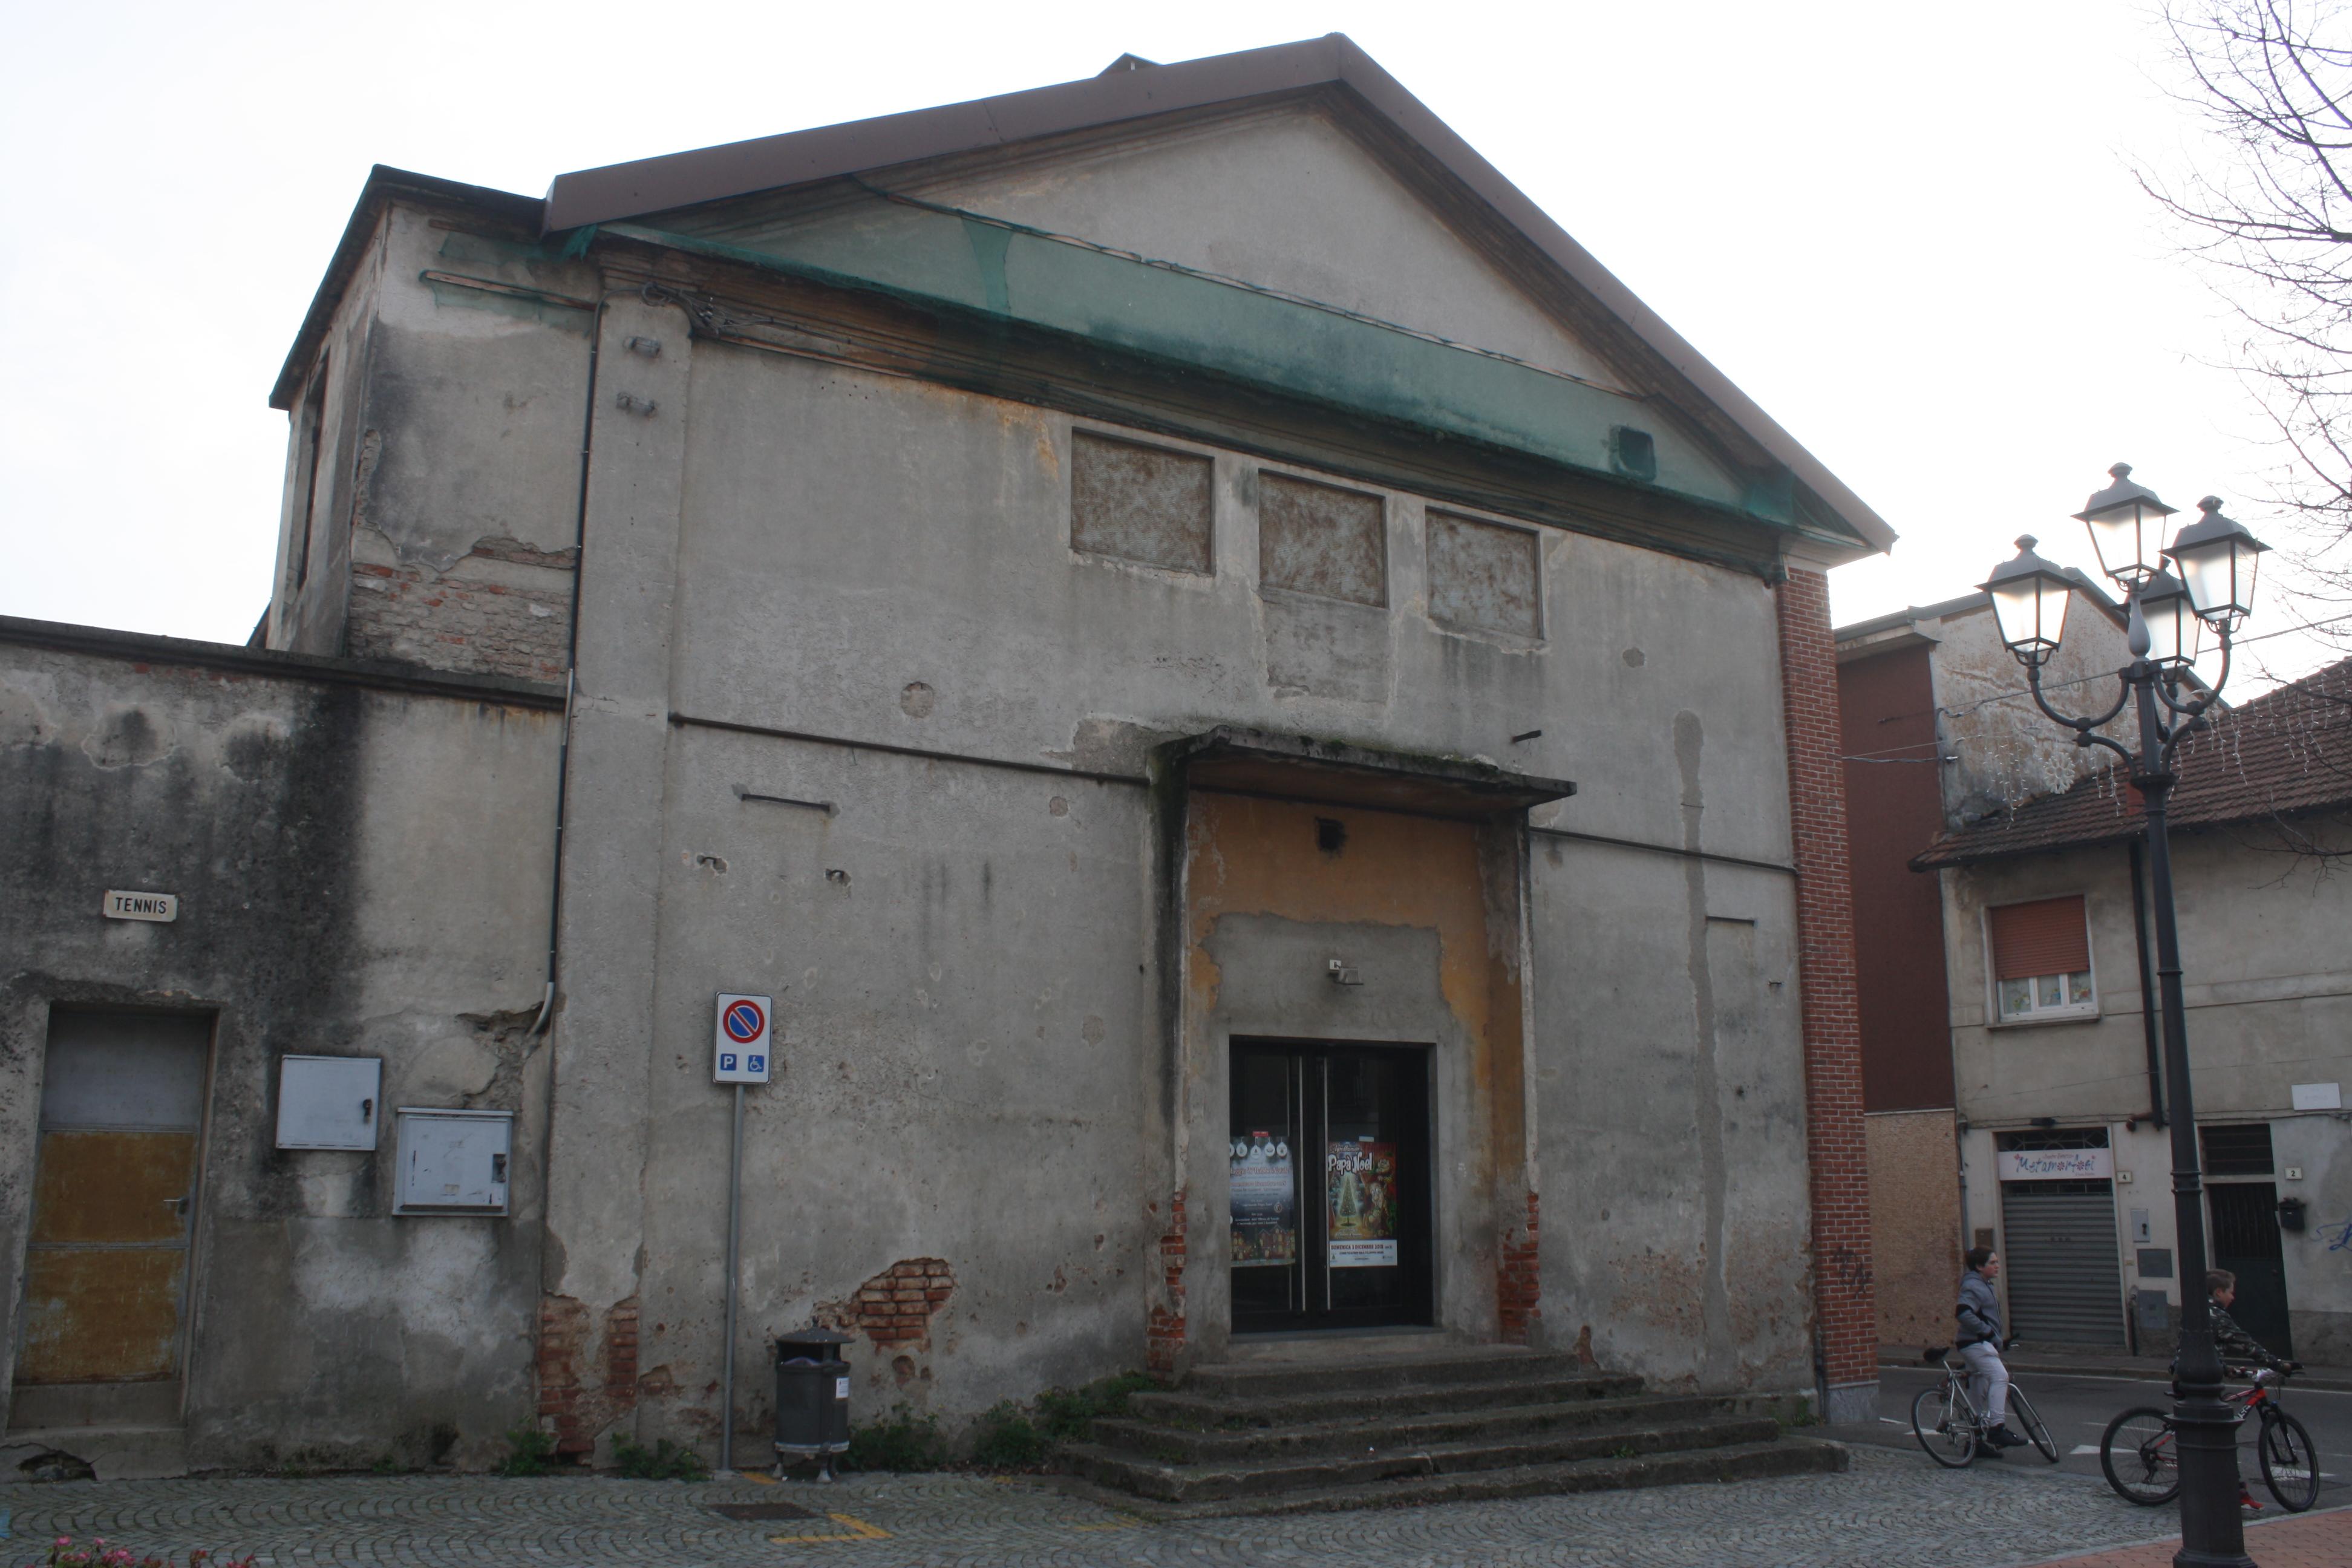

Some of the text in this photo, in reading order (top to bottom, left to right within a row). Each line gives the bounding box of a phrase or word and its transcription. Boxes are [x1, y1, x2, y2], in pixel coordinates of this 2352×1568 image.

[116, 897, 166, 914] TENNIS
[724, 1056, 733, 1068] P
[1328, 1151, 1373, 1175] Papà Noel
